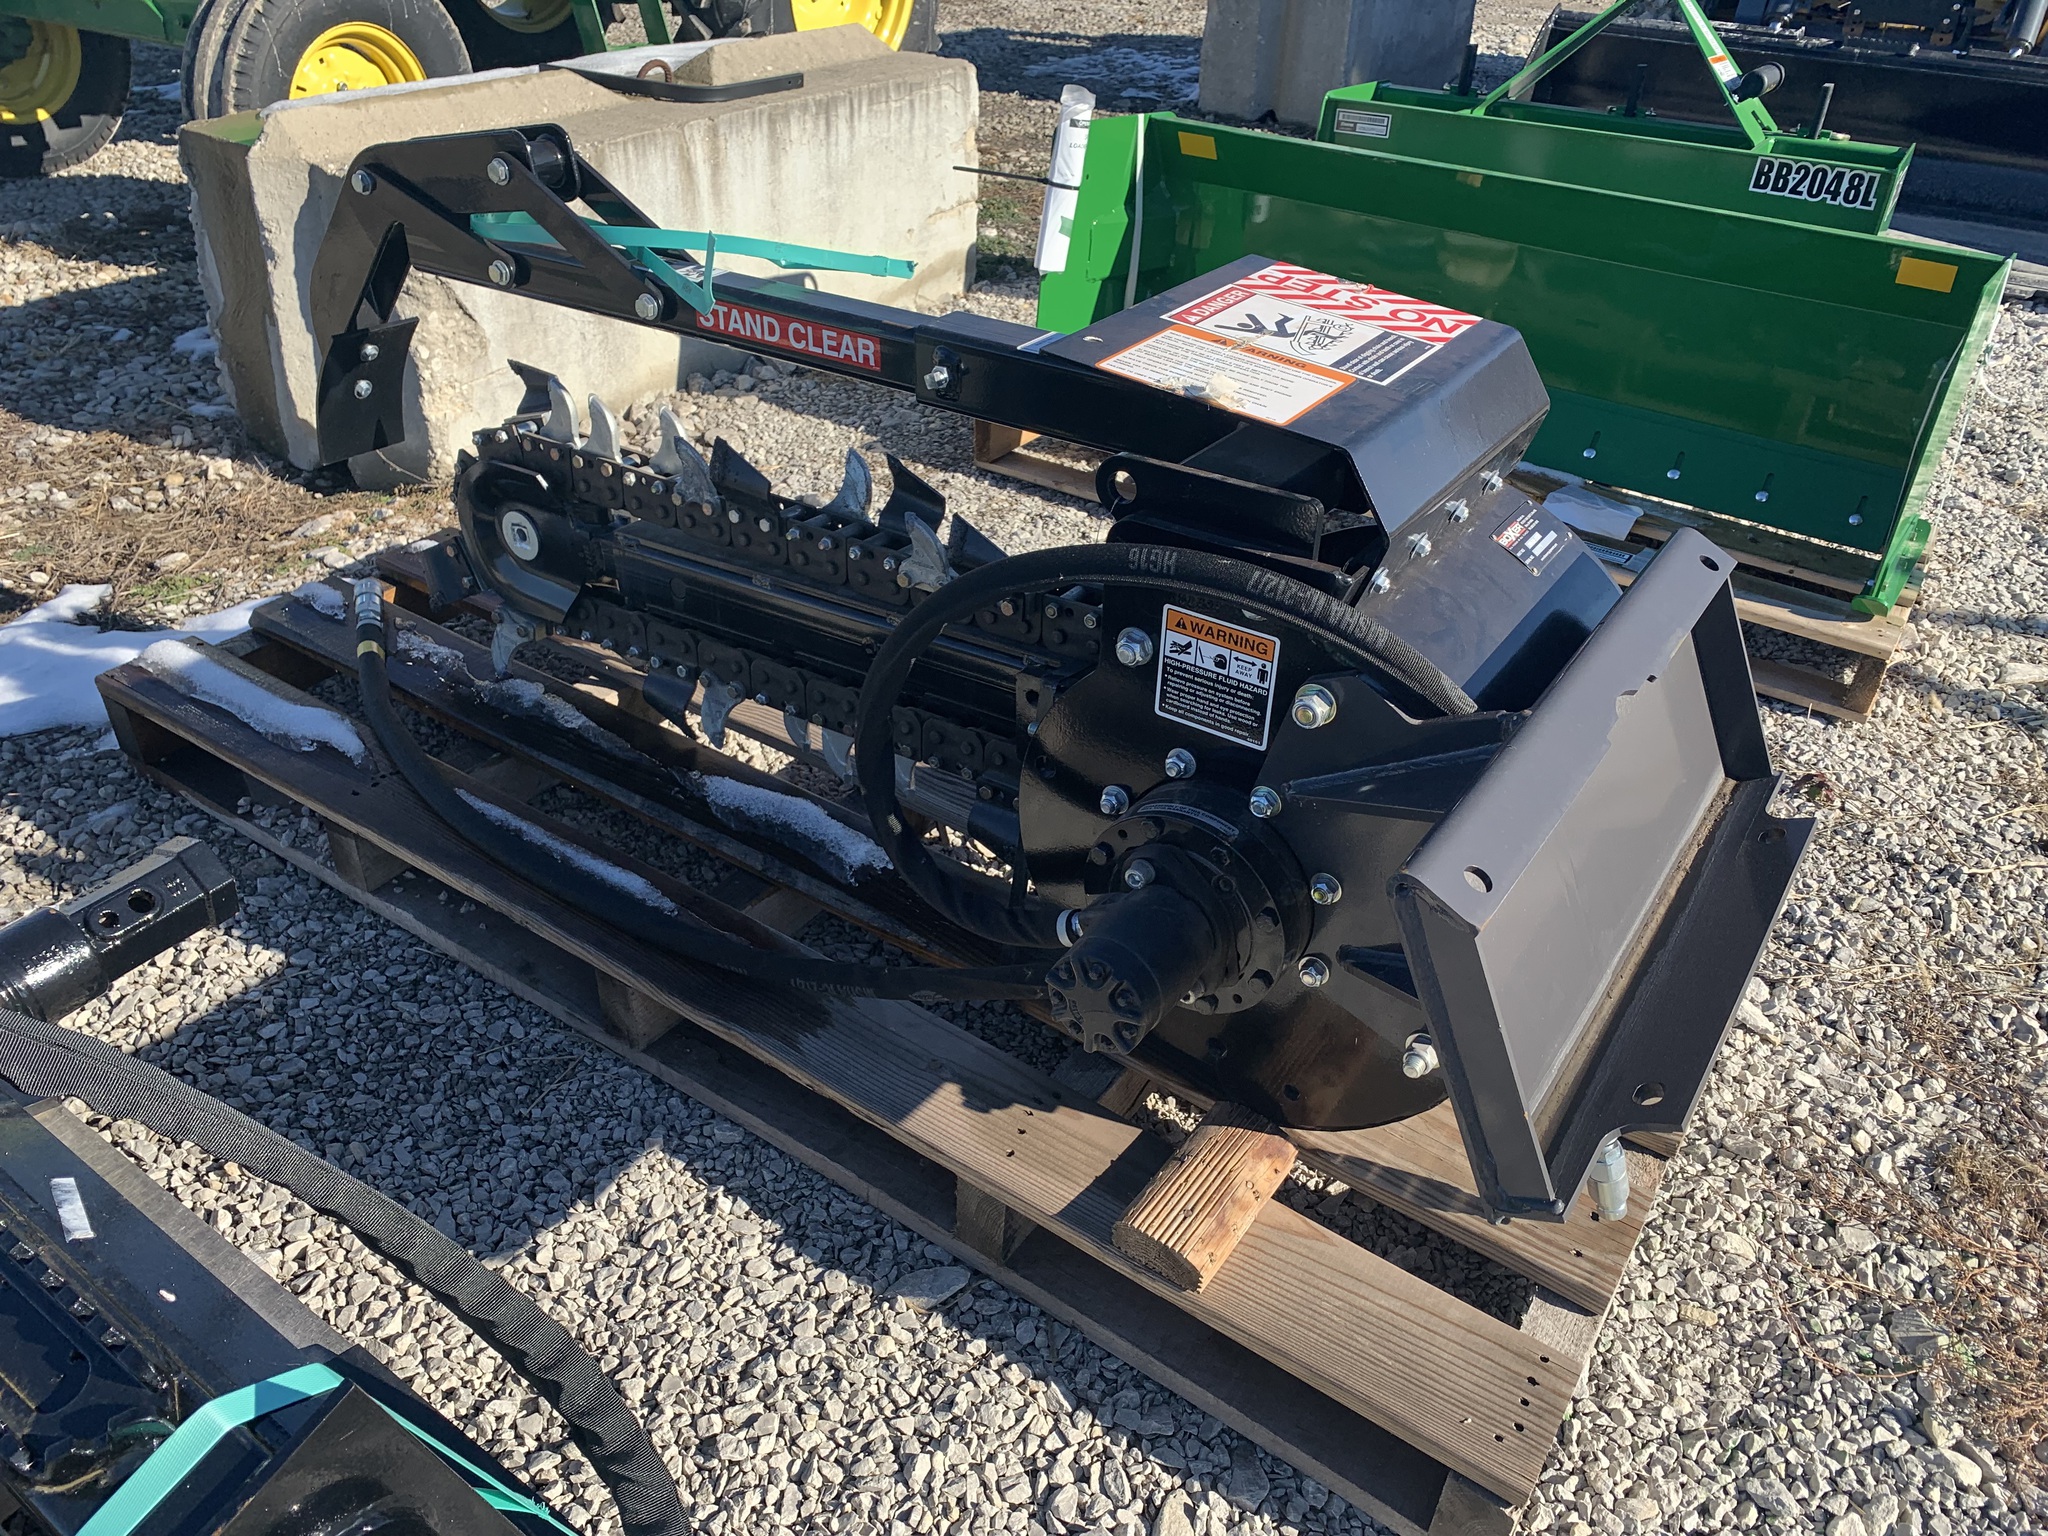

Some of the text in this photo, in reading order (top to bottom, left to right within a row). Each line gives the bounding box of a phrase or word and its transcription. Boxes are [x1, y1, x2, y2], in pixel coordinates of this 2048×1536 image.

[1751, 157, 1879, 209] BB2048L
[1201, 290, 1250, 317] DANGER
[1257, 274, 1463, 334] NO STEP
[700, 305, 875, 367] STAND CLEAR
[1243, 346, 1307, 369] ARNING
[1189, 620, 1268, 655] WARNING
[1164, 657, 1267, 696] HIGH-PRESSURE FLUID HAZARD
[1173, 669, 1193, 680] prevent
[1194, 676, 1213, 686] serious
[1214, 682, 1229, 692] injury
[1235, 669, 1252, 678] AWAY
[1236, 664, 1252, 672] KEEP
[1166, 680, 1188, 692] repairing
[1195, 690, 1217, 702] adjusting
[1166, 687, 1179, 695] Wear
[1179, 692, 1195, 701] proper
[1196, 697, 1208, 705] hand
[1229, 708, 1254, 721] protection
[1167, 675, 1185, 684] Relieve
[1185, 681, 1207, 693] pressure
[1215, 691, 1233, 701] system
[1234, 697, 1250, 706] before
[1165, 697, 1189, 709] cardboard
[1190, 706, 1208, 716] instead
[1165, 704, 1177, 713] Keep
[1184, 711, 1214, 725] components
[1220, 724, 1233, 732] good
[1166, 692, 1178, 700] when
[1179, 697, 1203, 709] searching
[1237, 717, 1251, 725] wood
